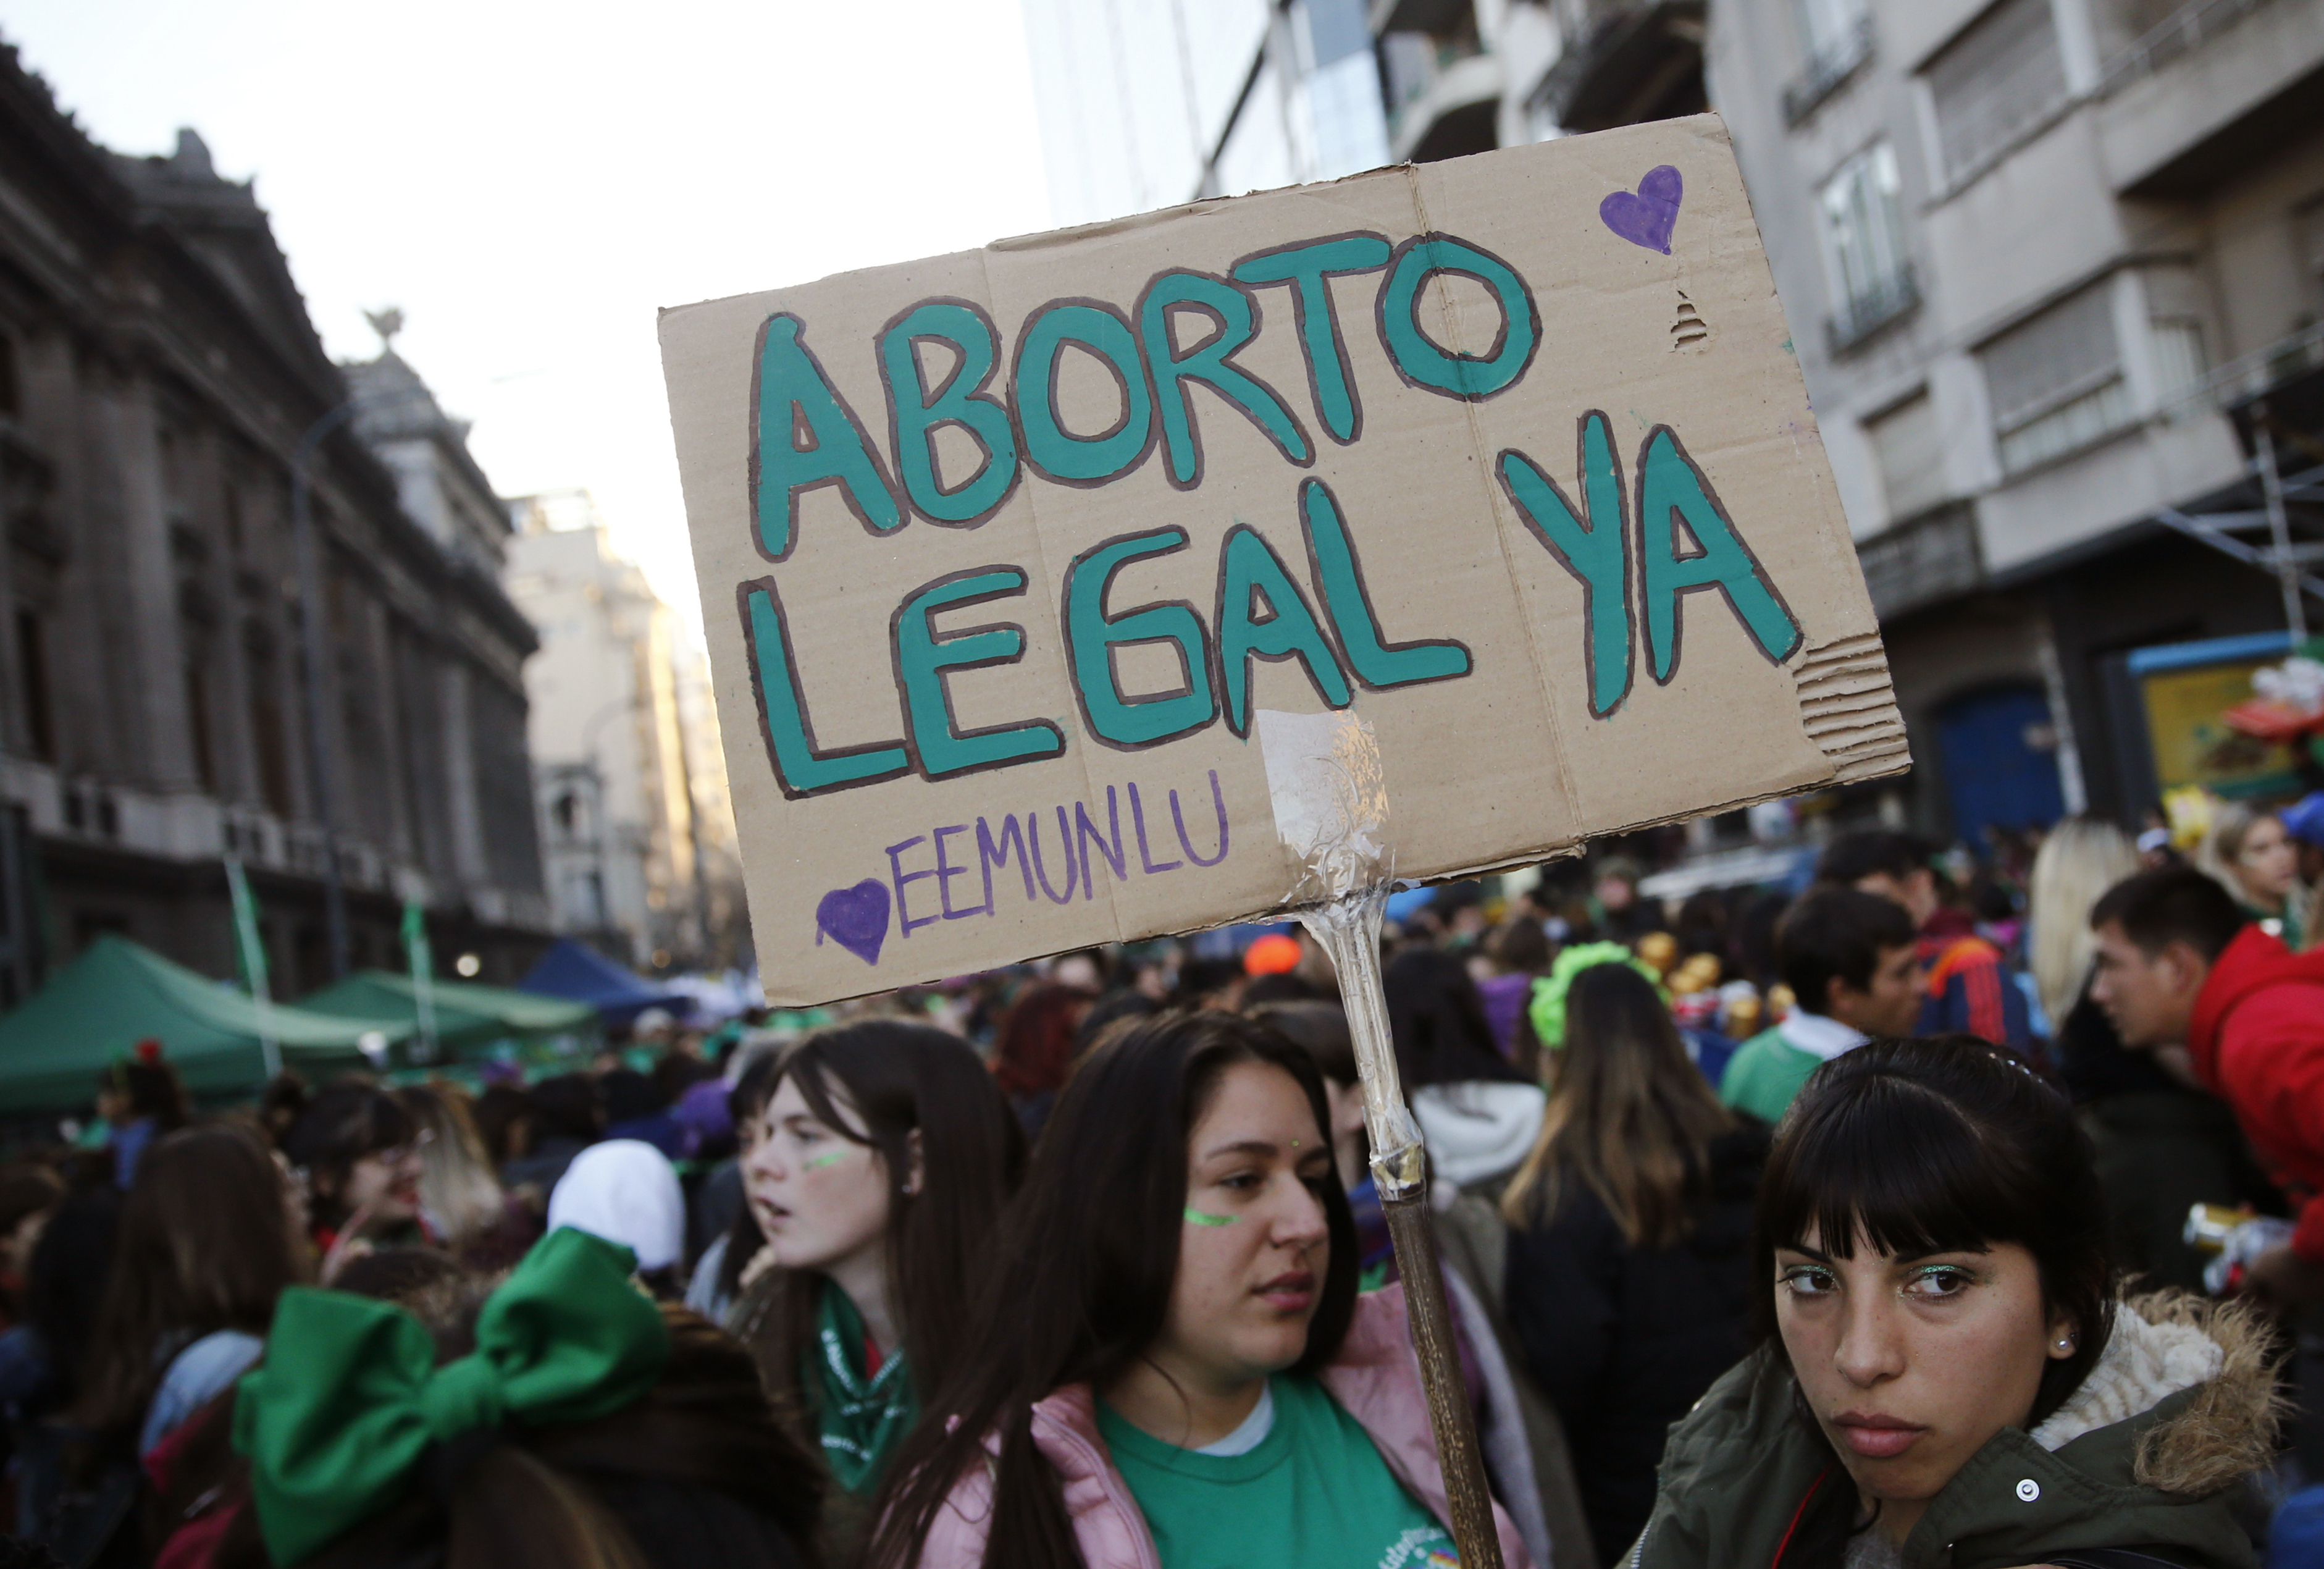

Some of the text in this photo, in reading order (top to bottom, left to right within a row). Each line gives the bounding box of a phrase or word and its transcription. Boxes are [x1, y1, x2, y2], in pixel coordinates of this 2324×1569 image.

[749, 231, 1541, 560] ABORTO
[737, 409, 1803, 799] LEGAL YA
[887, 770, 1230, 935] EEMUNLU
